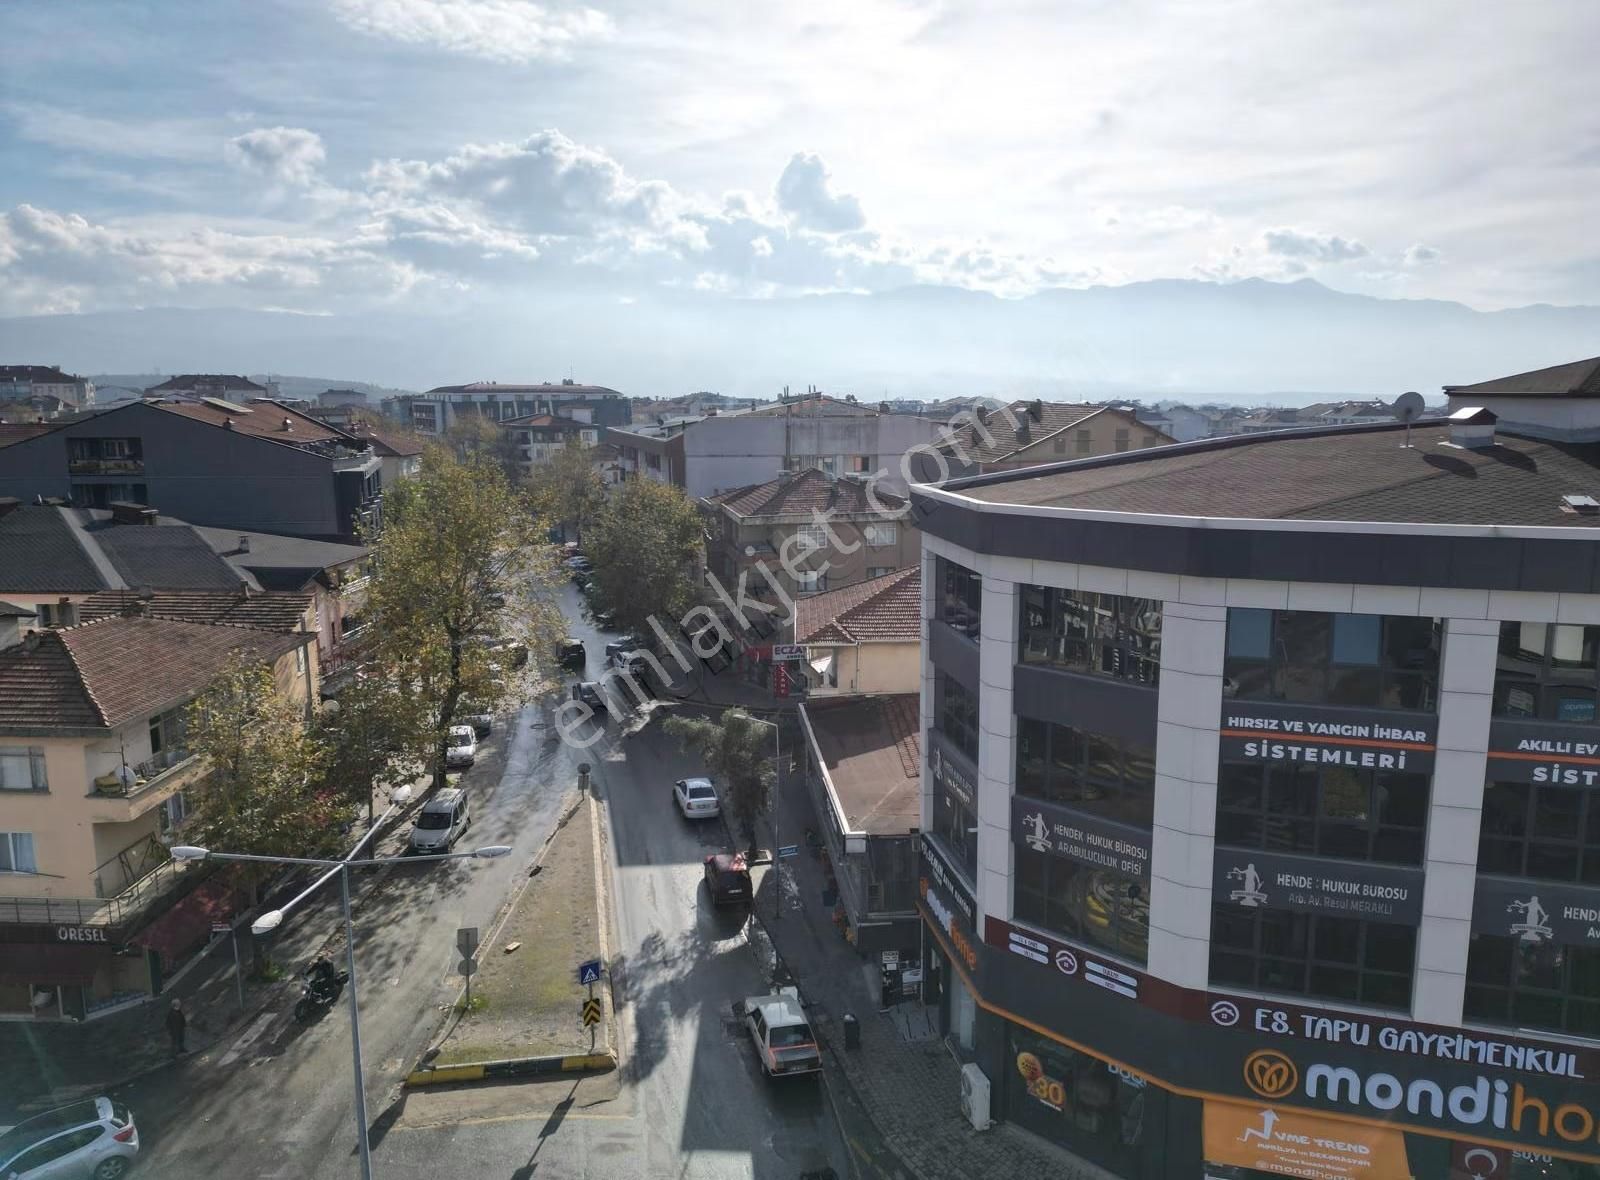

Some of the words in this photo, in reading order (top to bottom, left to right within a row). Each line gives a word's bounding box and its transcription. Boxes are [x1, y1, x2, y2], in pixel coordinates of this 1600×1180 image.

[1228, 716, 1278, 730] HIRSIZ
[1282, 720, 1303, 732] VE
[1307, 722, 1369, 737] YANGIN
[1374, 724, 1427, 742] İHBAR
[1244, 739, 1406, 769] SİSTEMLERİ
[1517, 739, 1571, 753] AKILLI
[1575, 743, 1598, 755] EV
[1532, 763, 1598, 785] SİST
[1054, 823, 1084, 841] HENDEK
[1086, 832, 1114, 850] HUKUK
[1057, 841, 1118, 869] ARABULUCULUK
[1322, 879, 1360, 895] HUKUK
[1301, 1014, 1370, 1047] TAPU
[1378, 1027, 1585, 1079] GAYRİMENKUL
[1305, 1063, 1600, 1146] mondiho
[1313, 1138, 1370, 1155] TREND
